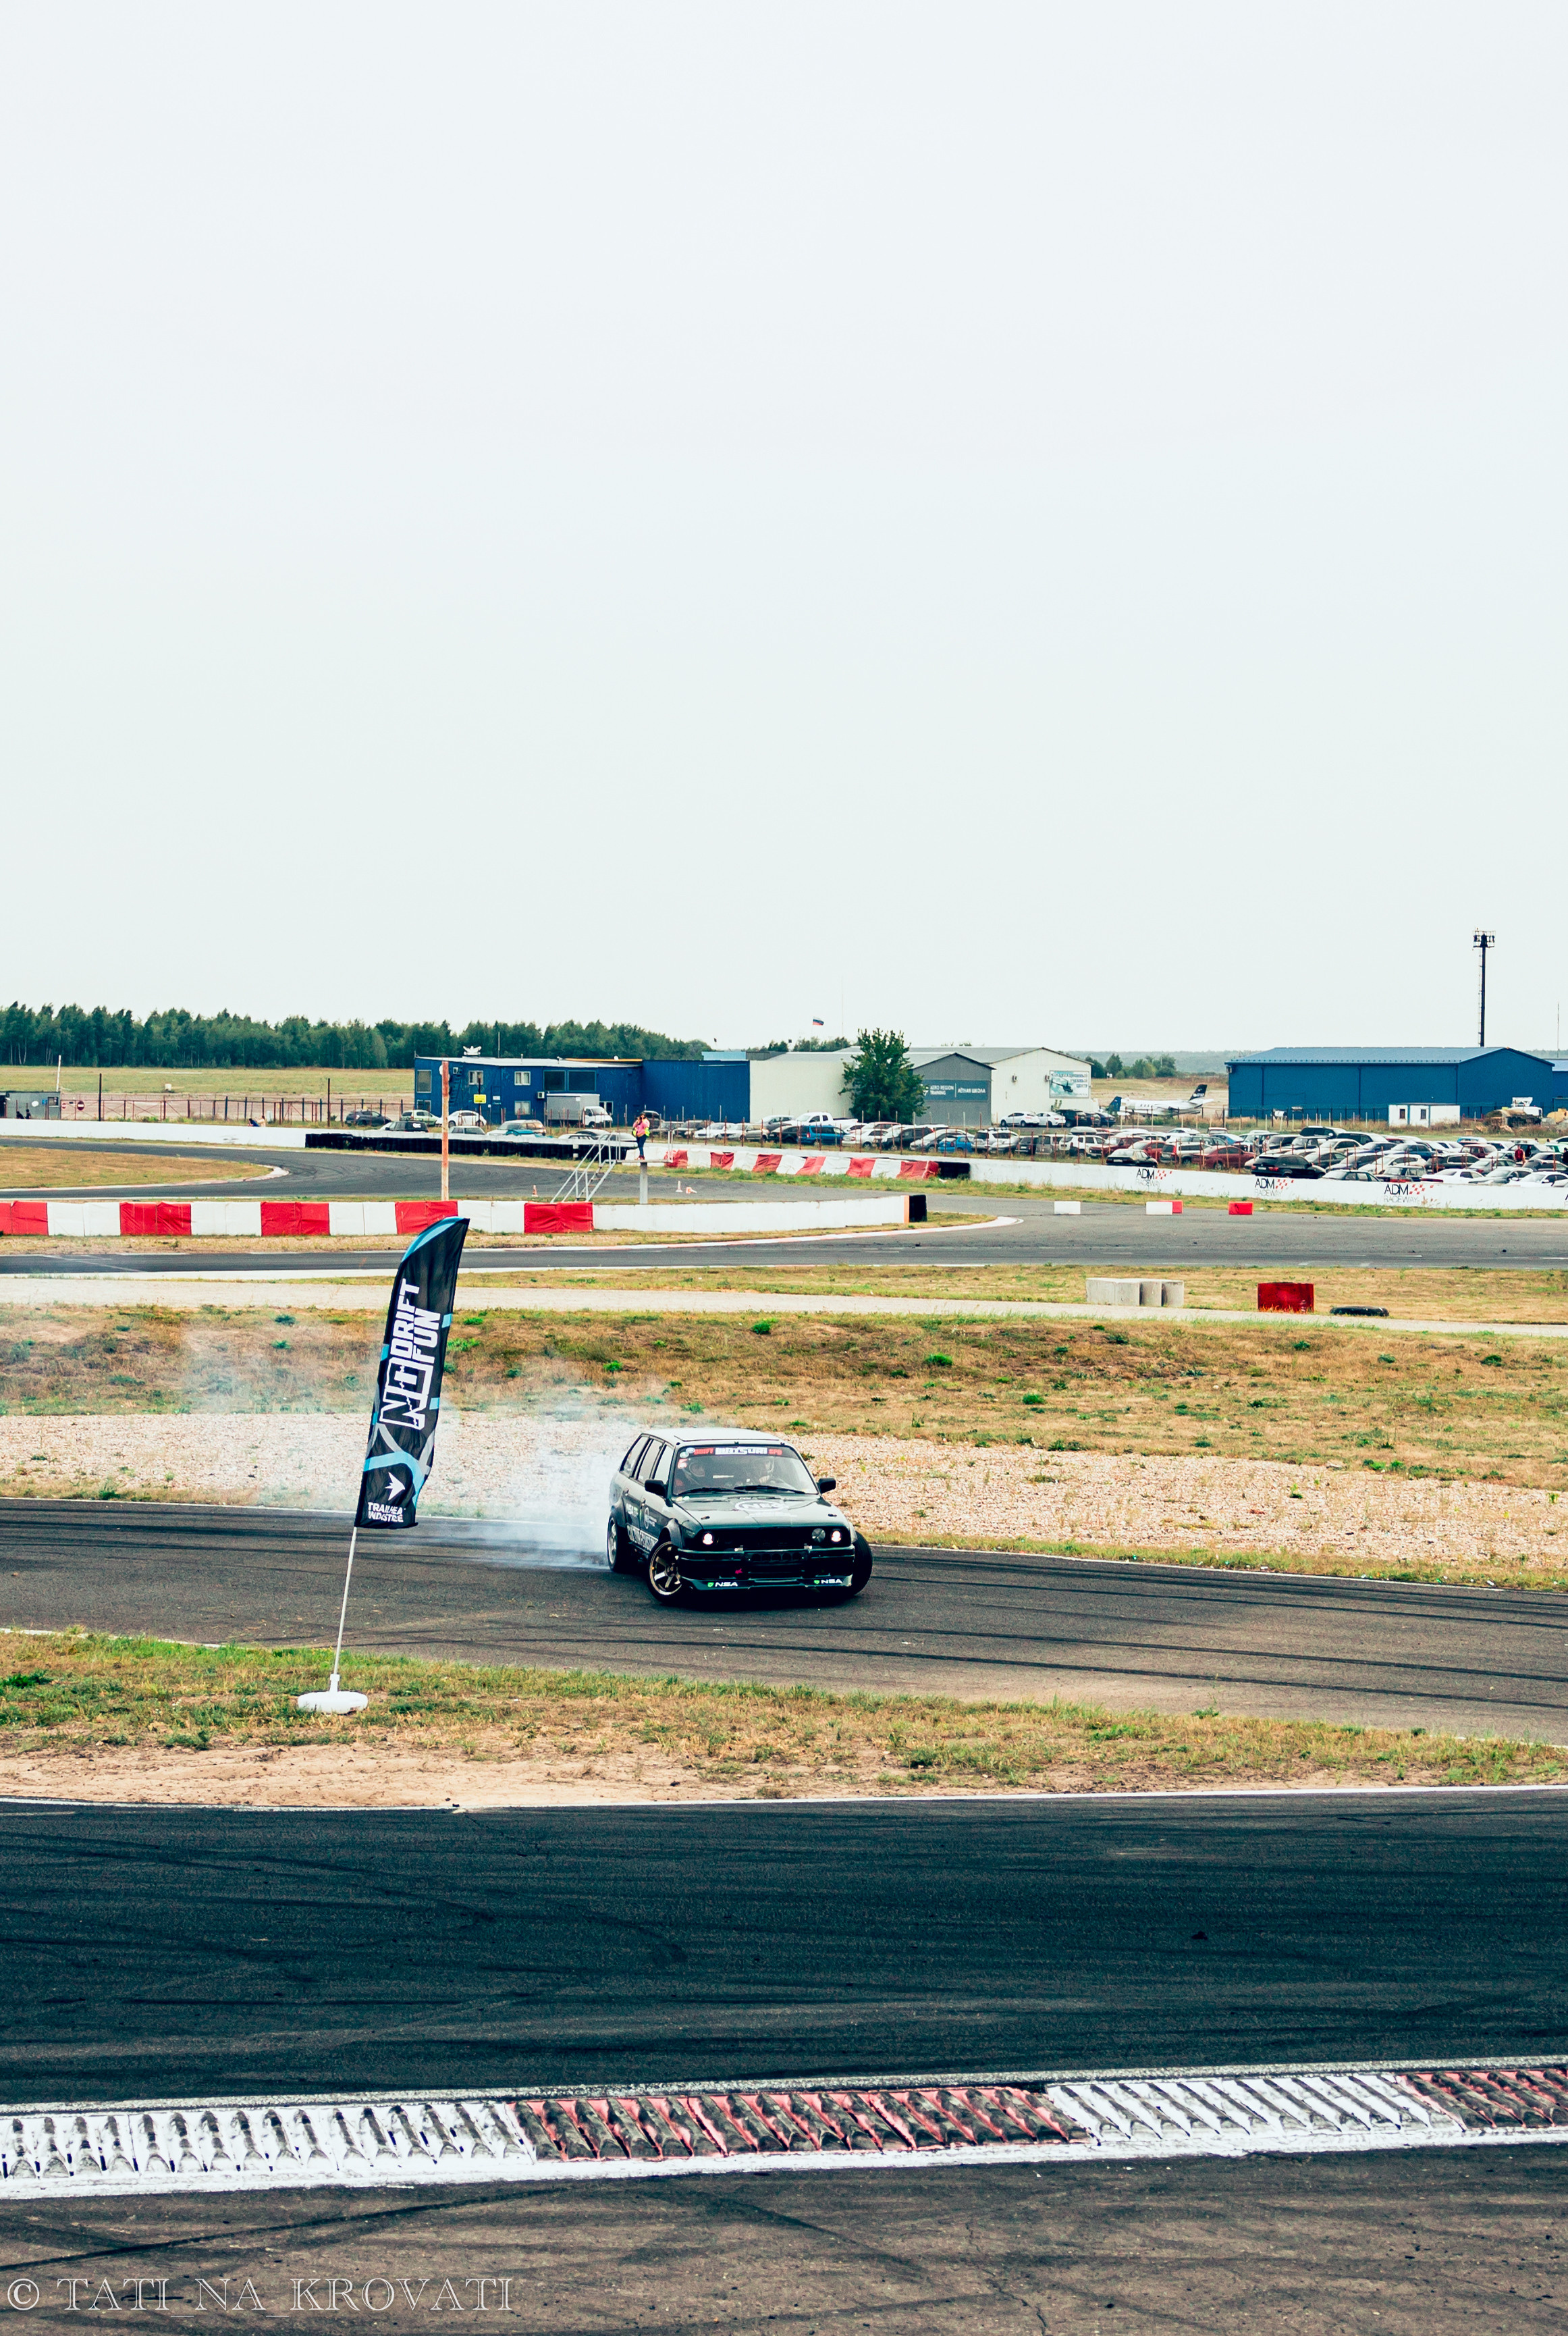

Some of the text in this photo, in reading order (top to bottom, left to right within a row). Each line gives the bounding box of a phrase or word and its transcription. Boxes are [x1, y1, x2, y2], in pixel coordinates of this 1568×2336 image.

[1136, 1168, 1154, 1179] ADM
[1255, 1177, 1274, 1189] ADM
[1384, 1184, 1409, 1195] ADM
[1384, 1195, 1418, 1203] RACEWAY
[390, 1278, 420, 1359] DRIFT
[412, 1308, 441, 1364] FUN
